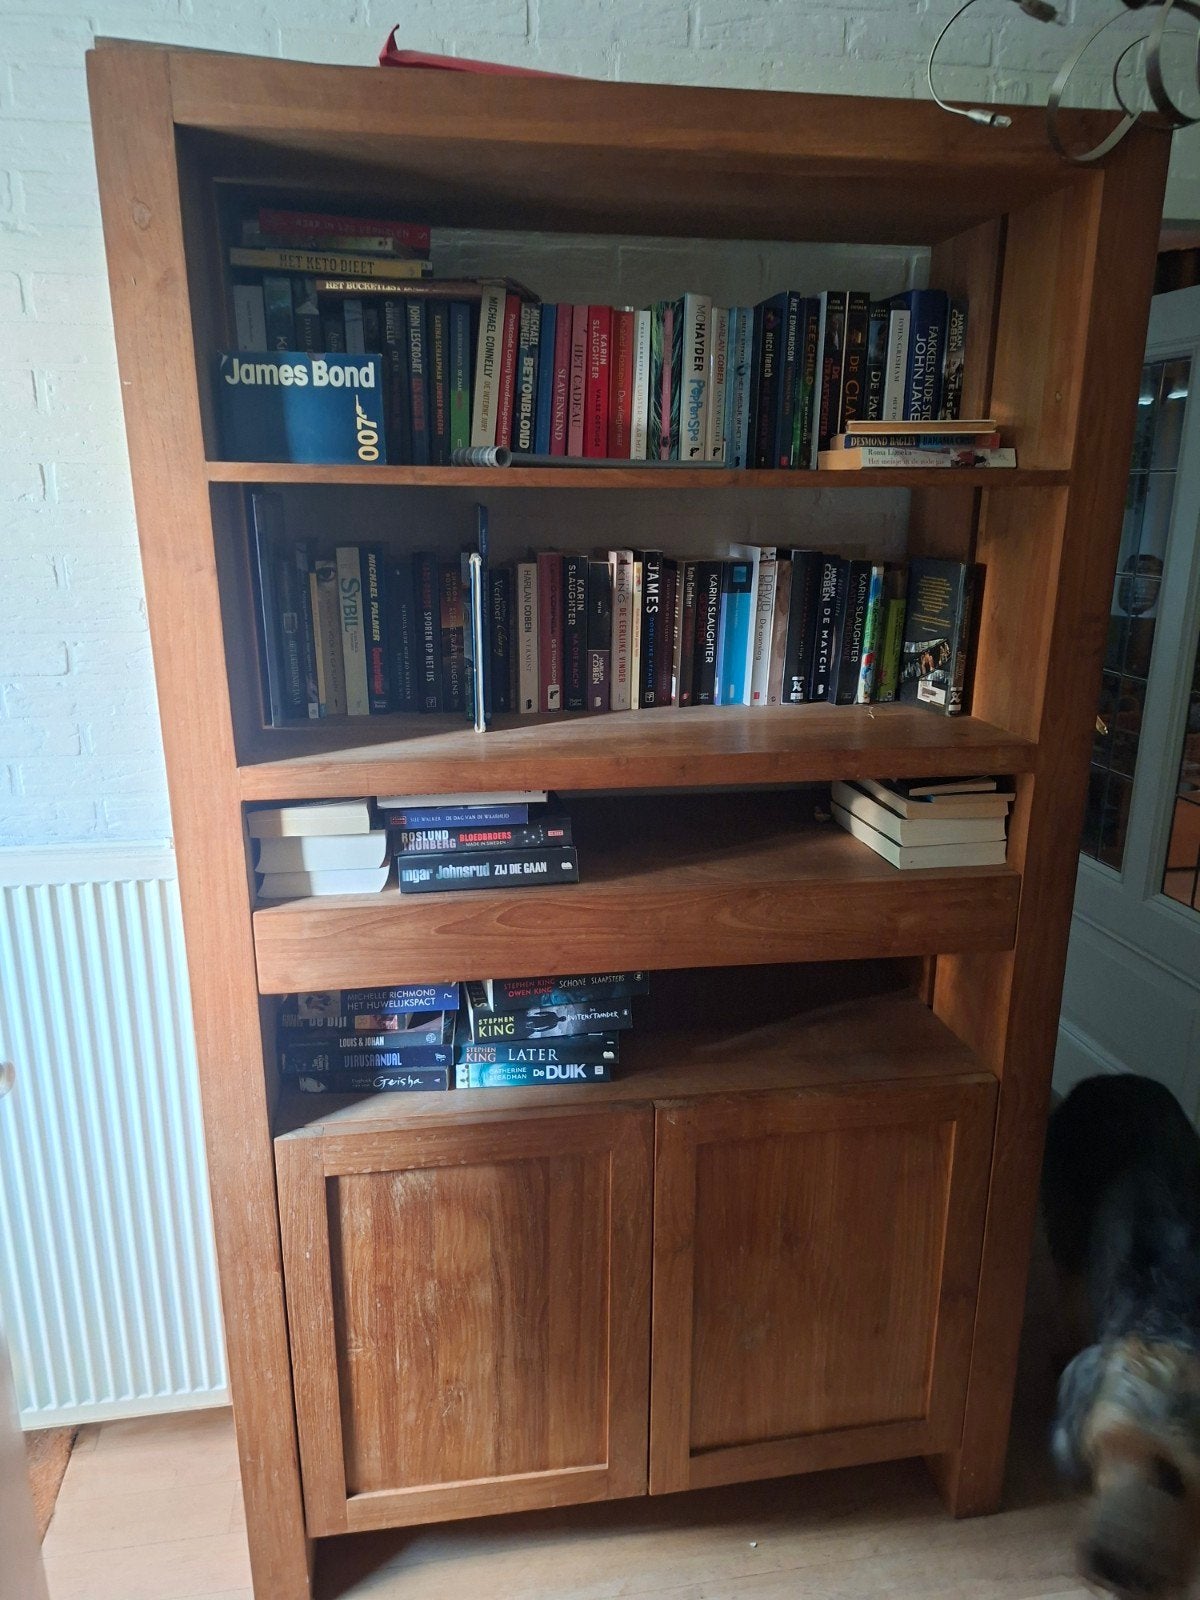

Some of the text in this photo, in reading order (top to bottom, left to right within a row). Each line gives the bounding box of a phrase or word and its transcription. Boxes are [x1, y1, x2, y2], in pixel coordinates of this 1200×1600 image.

[280, 254, 375, 274] HET KETO DIEET
[408, 305, 421, 326] JOHN
[487, 296, 498, 333] MICHAEL
[790, 298, 799, 312] ÅKE
[384, 301, 395, 345] CONNELLY
[521, 309, 530, 350] CONNELLY
[530, 309, 540, 346] MICHAEL
[619, 316, 628, 347] Khaled
[739, 315, 747, 336] ROBERT
[787, 315, 798, 361] EDWARDSON
[949, 309, 958, 351] COBEN
[410, 328, 422, 374] LESCROART
[484, 336, 496, 378] CONNELLY
[592, 320, 600, 378] SLAUGHTER
[600, 334, 608, 365] KARIN
[764, 332, 773, 352] nicci
[805, 316, 817, 385] LEE CHILD
[894, 318, 905, 382] JOHN GRISHAM
[913, 334, 926, 379] JOHN
[224, 358, 375, 388] James Bond
[501, 314, 516, 434] Postcode Loterij Voordeelagenda
[715, 316, 727, 442] HARLAN COBEN ONTWRICHT
[764, 354, 774, 377] french
[832, 365, 840, 380] DE
[849, 356, 859, 373] DE
[923, 326, 939, 402] FAKKELS IN DE
[572, 344, 583, 428] HET CADEAU
[870, 371, 881, 389] DE
[482, 390, 490, 416] INTERNE
[519, 357, 533, 449] BETONBLOND
[555, 369, 566, 440] SLAVENKIND
[617, 390, 626, 404] De
[355, 396, 380, 462] 007
[615, 405, 625, 446] vliegeraar
[851, 436, 887, 446] DESMOND
[368, 554, 380, 642] MICHAEL PALMER
[524, 570, 532, 603] HARLAN
[568, 564, 576, 626] SLAUGHTER
[646, 562, 659, 614] JAMES
[686, 582, 694, 608] Gardner
[762, 574, 774, 612] DAVID
[822, 564, 831, 602] COBEN
[340, 578, 360, 633] SYBIL
[494, 580, 504, 621] Verhoef
[619, 607, 627, 617] DE
[424, 611, 433, 640] SPOREN
[524, 604, 532, 633] COBEN
[705, 574, 718, 663] KARIN SLAUGHTER
[851, 573, 867, 663] KARIN SLAUGHTER
[425, 643, 432, 654] OP
[552, 639, 556, 649] DE
[619, 620, 627, 653] EERLIJKE
[756, 618, 767, 661] De aanslag
[818, 608, 831, 673] DE MATCH
[425, 656, 433, 670] HET
[426, 672, 434, 682] IJS
[592, 654, 600, 684] COBEN
[401, 830, 449, 843] ROSLUND
[402, 839, 456, 851] THUNBERG
[459, 831, 512, 842] BLOEDBROERS
[436, 862, 490, 880] Johnsrud
[494, 862, 547, 876] ZIJ DIE GAAN
[348, 989, 436, 1001] MICHELLE RICHMOND
[504, 978, 555, 989] STEPHEN KING
[534, 986, 552, 994] KING
[348, 998, 436, 1011] HET HUWELIJKSPACT
[478, 1016, 515, 1025] STEPHEN
[478, 1024, 515, 1038] KING
[339, 1036, 385, 1048] LOUIS & JOHAN
[508, 1049, 559, 1061] LATER
[466, 1052, 497, 1063] KING
[533, 1064, 587, 1079] De DUIK
[372, 1075, 424, 1090] Geisha
